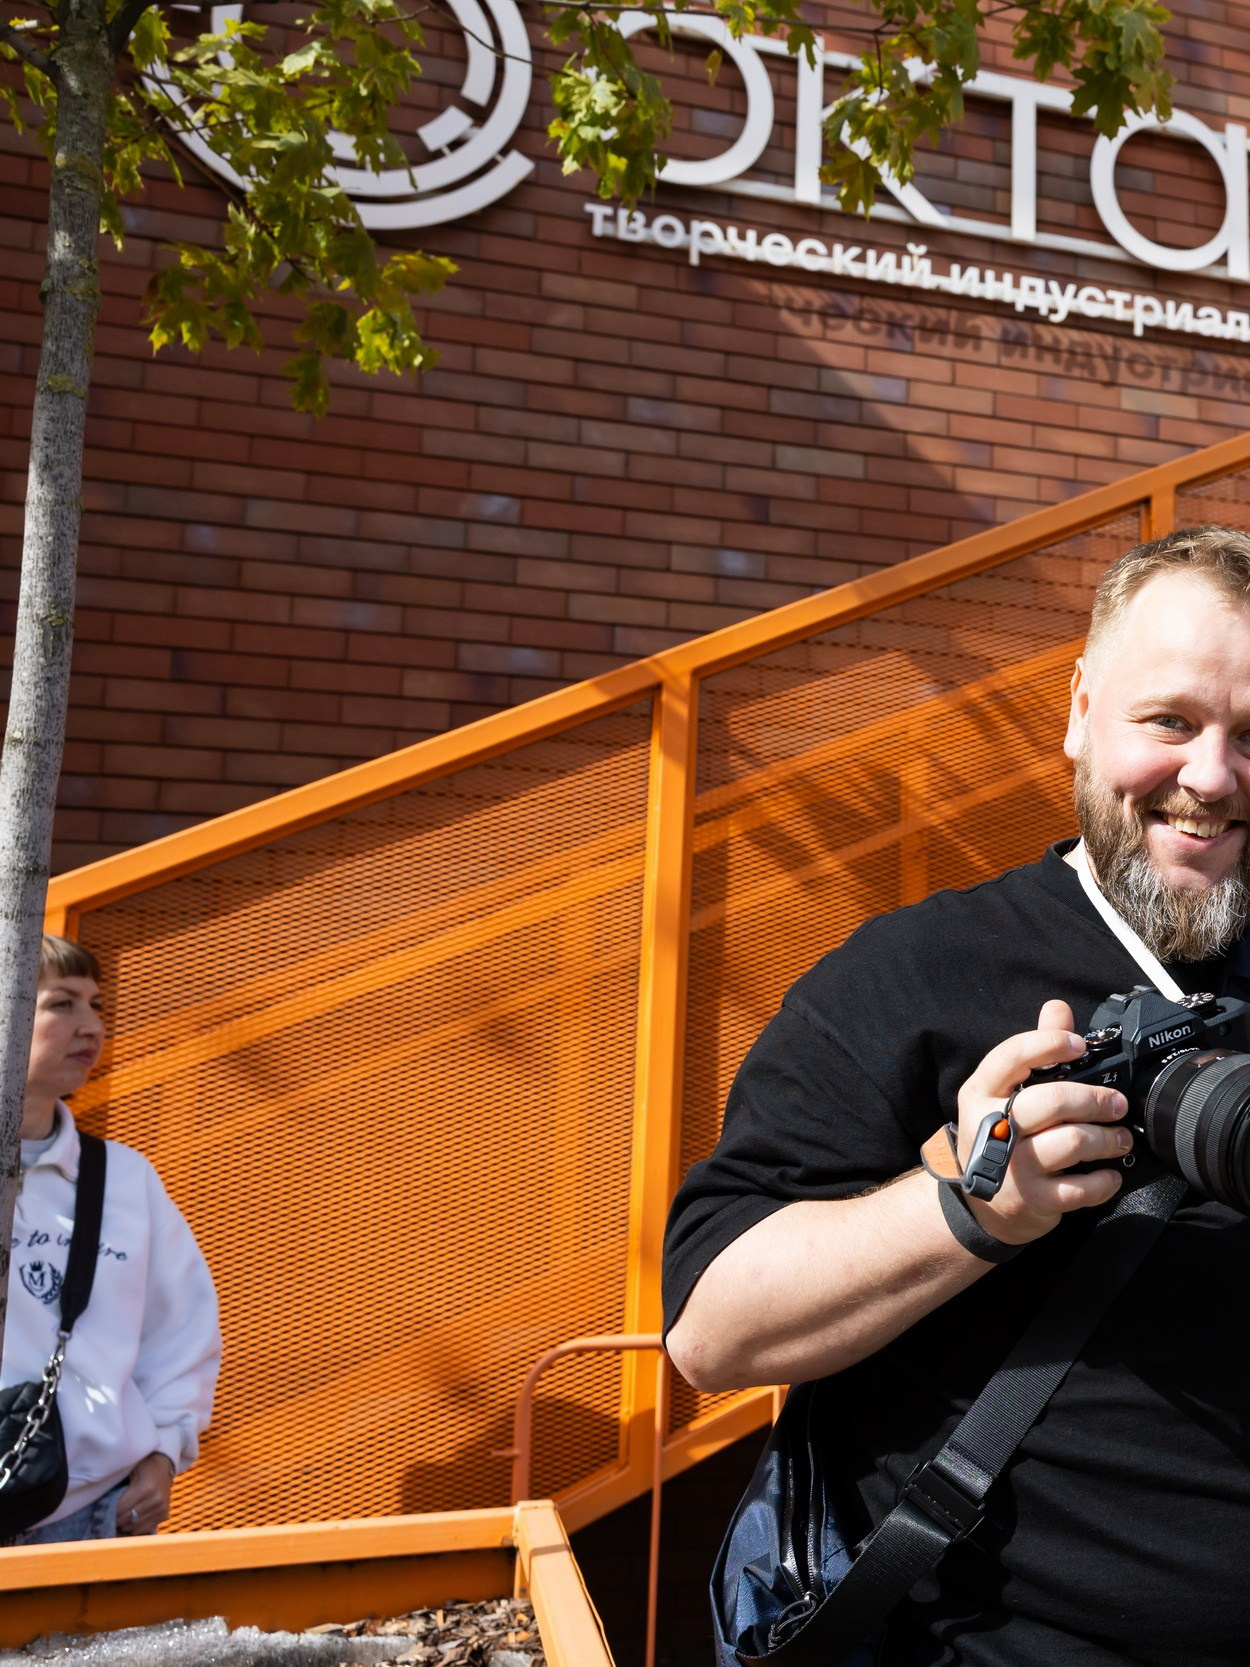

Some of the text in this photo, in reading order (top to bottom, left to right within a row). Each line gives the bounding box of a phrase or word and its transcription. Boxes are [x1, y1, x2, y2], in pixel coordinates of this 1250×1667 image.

[584, 202, 933, 291] творческий
[1149, 1025, 1191, 1048] Nikon
[27, 1230, 49, 1247] to
